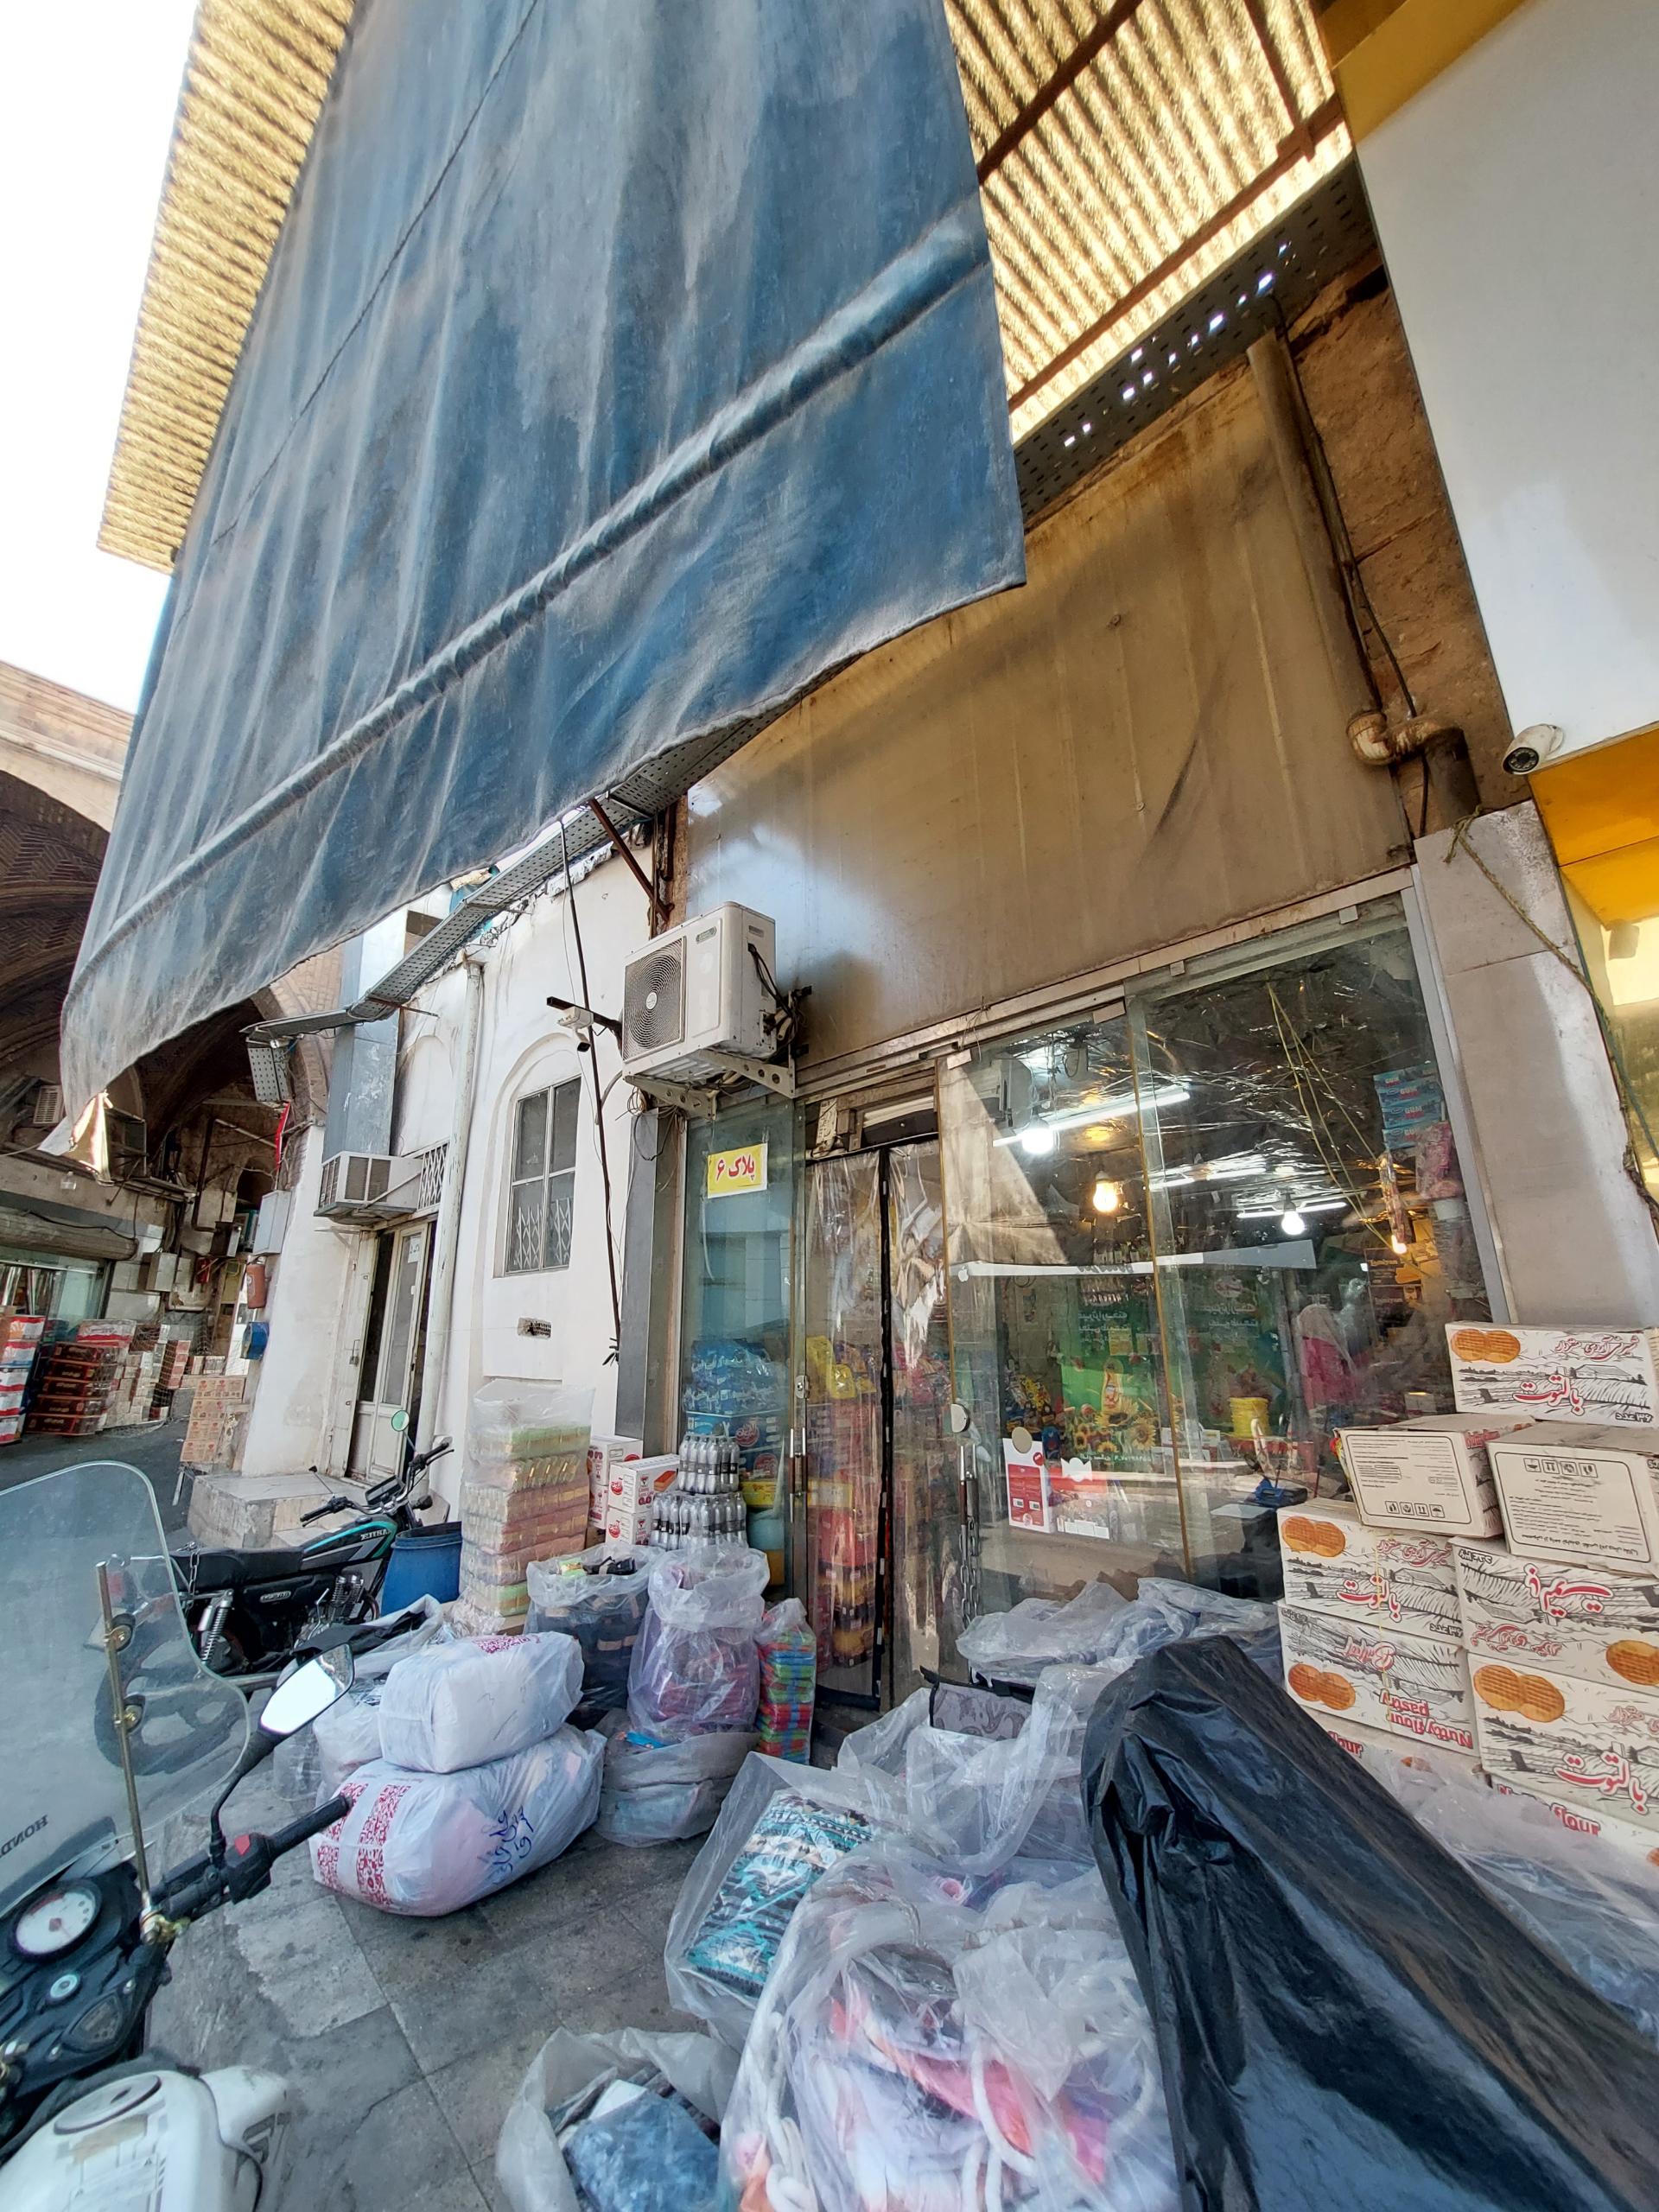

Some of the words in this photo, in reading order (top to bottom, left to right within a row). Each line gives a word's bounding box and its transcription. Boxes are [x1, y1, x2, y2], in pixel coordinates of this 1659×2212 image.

[728, 1154, 755, 1181] پلاک
[360, 1529, 391, 1541] EHSA
[1380, 1688, 1430, 1717] pastry
[1387, 1712, 1426, 1735] flour
[1426, 1717, 1473, 1750] Nutty
